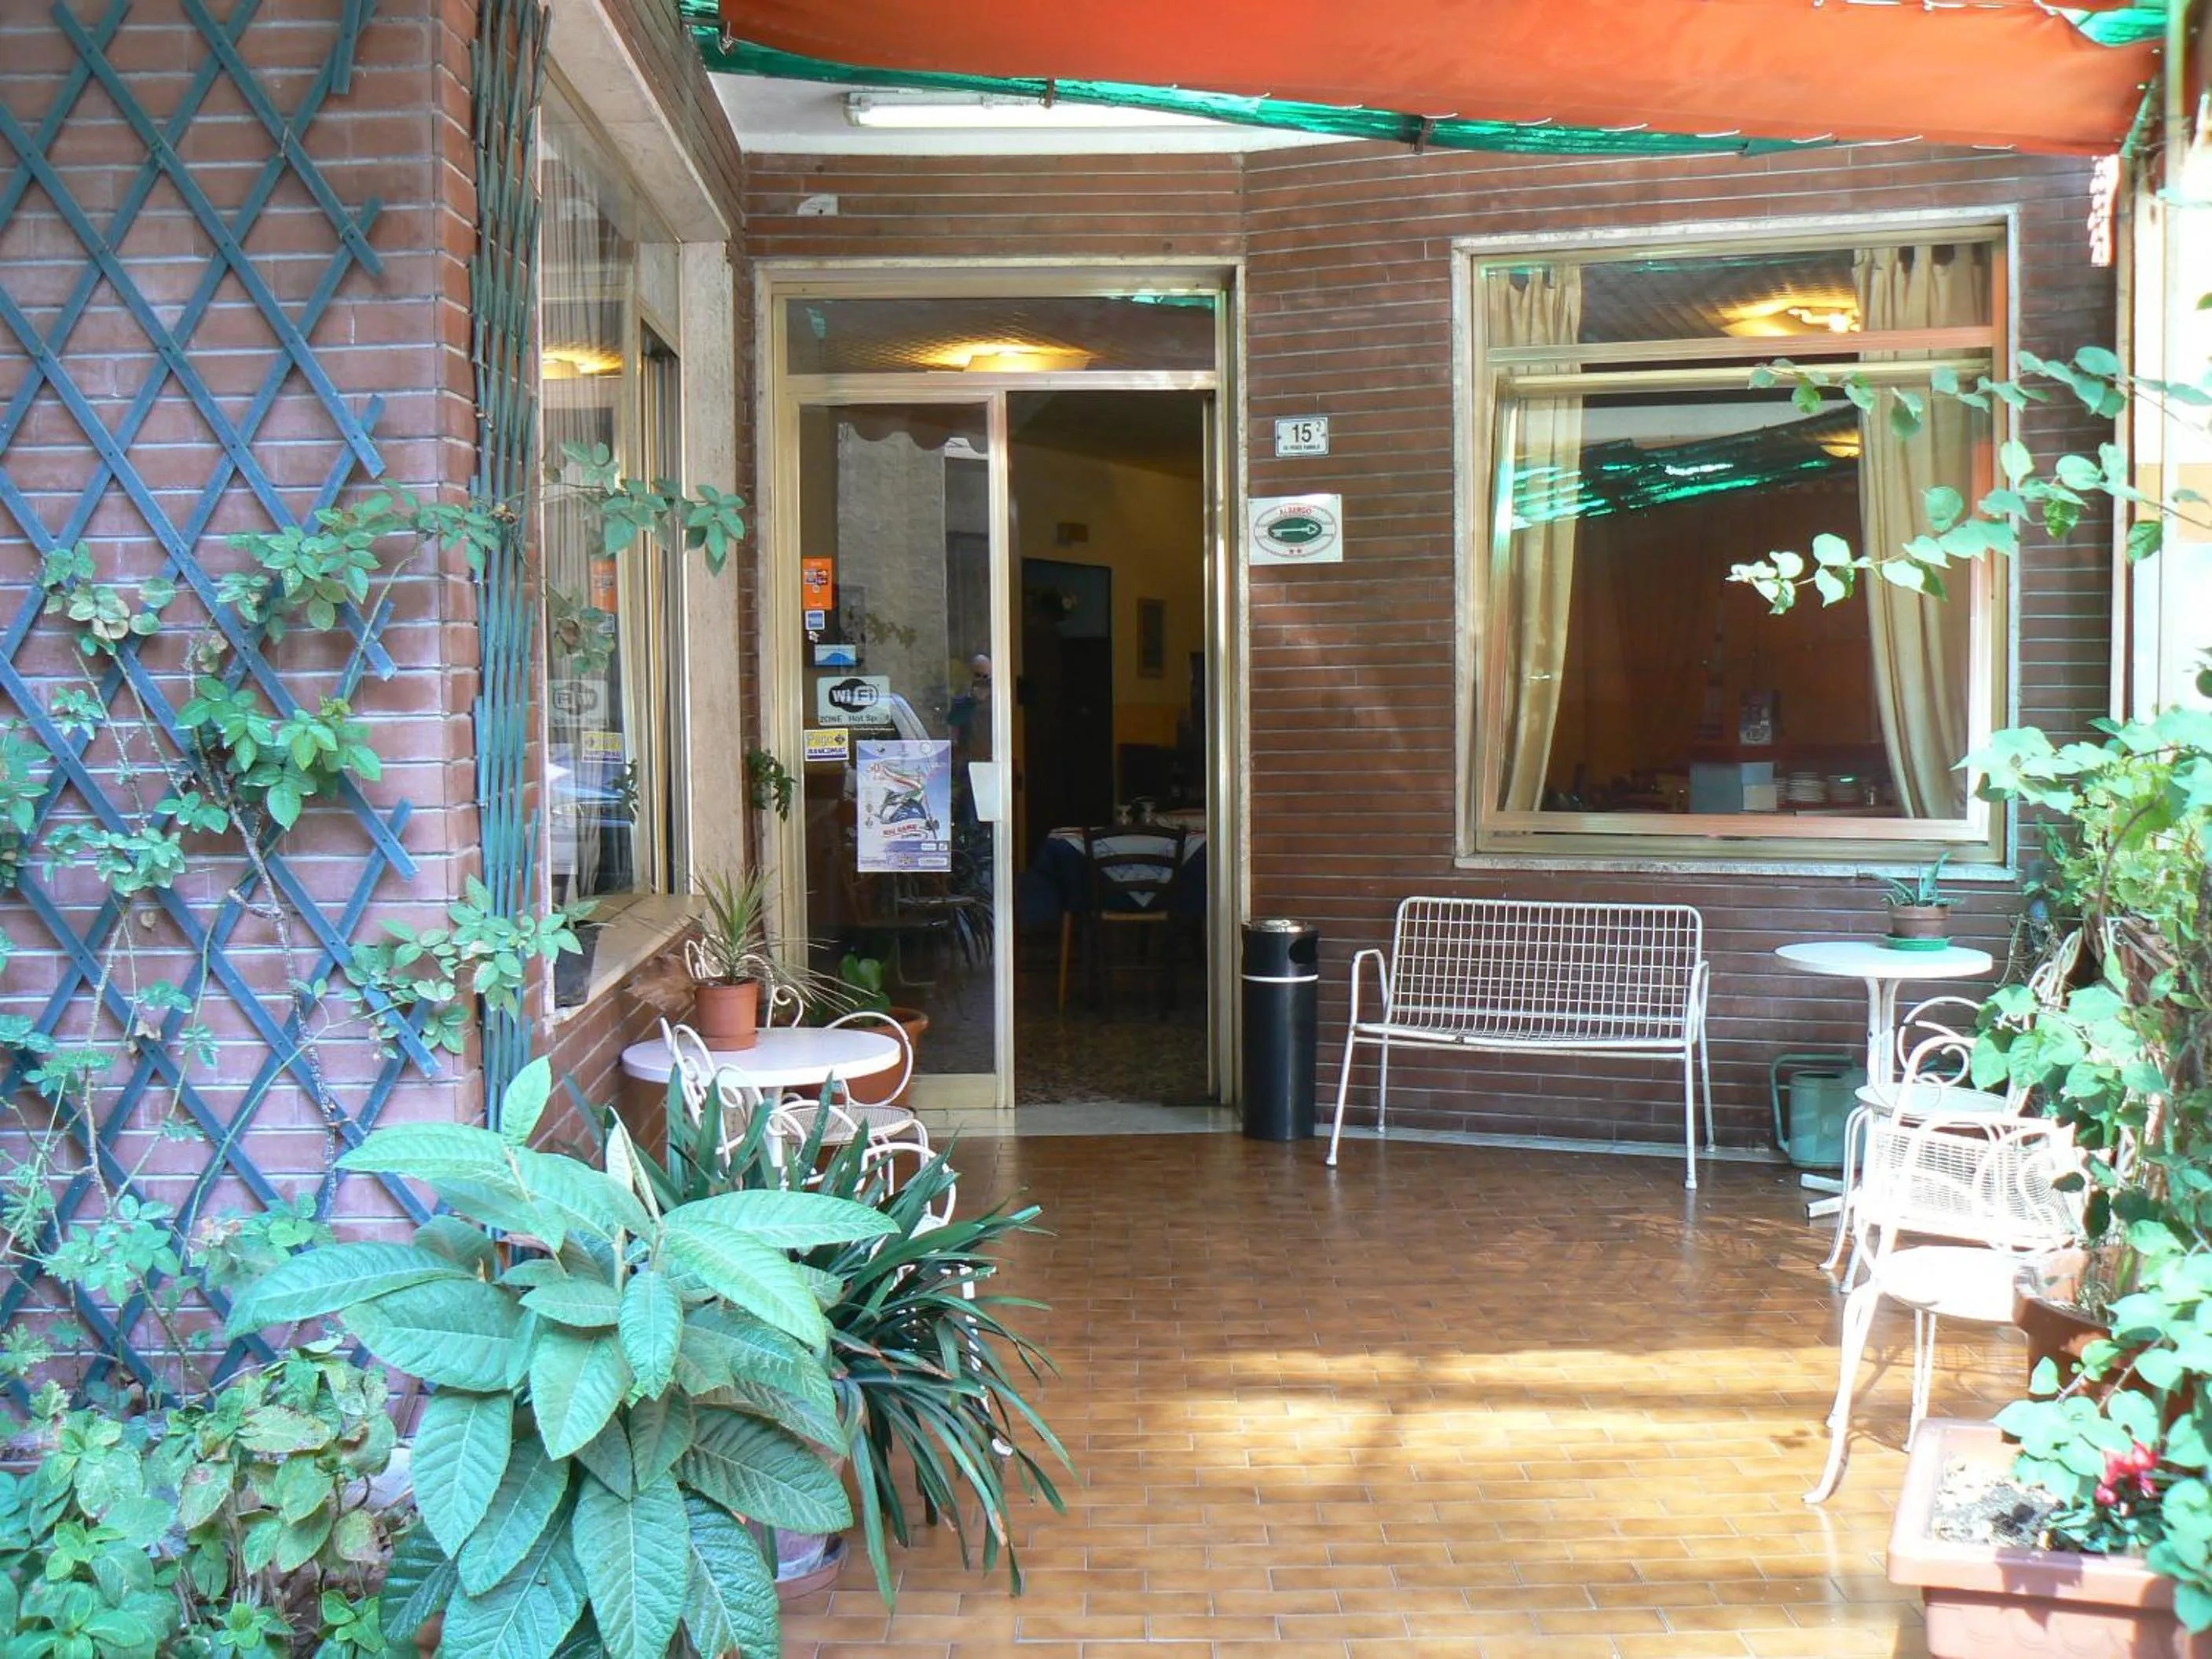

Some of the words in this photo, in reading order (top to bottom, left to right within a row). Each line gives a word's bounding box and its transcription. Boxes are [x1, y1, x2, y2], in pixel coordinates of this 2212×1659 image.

[1291, 423, 1312, 443] 15
[1279, 506, 1312, 515] ALBERGO
[848, 714, 865, 723] Hot
